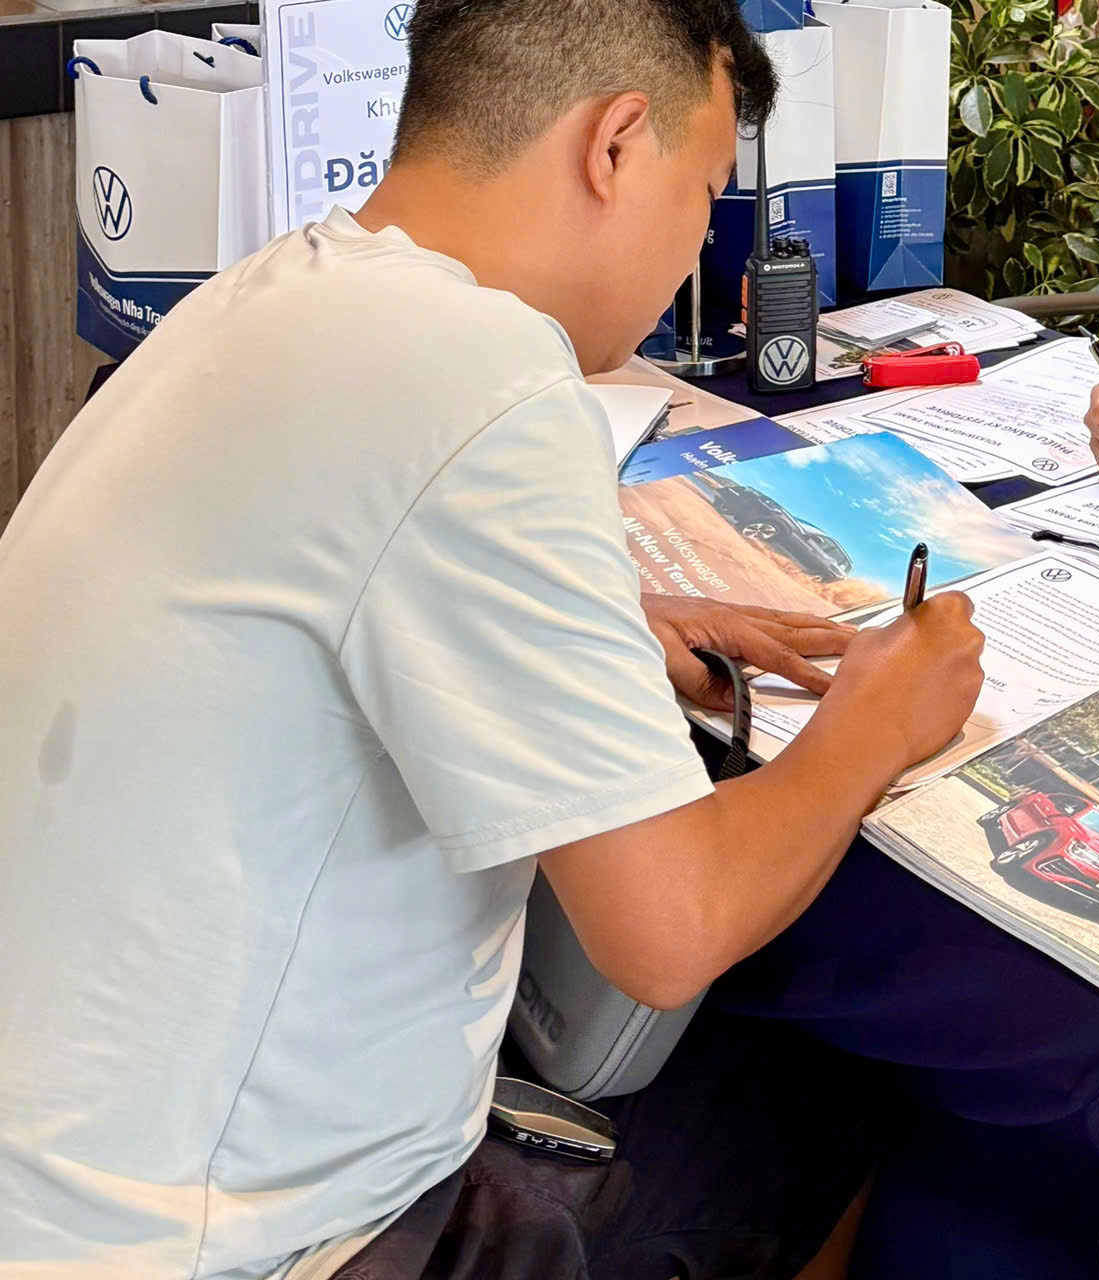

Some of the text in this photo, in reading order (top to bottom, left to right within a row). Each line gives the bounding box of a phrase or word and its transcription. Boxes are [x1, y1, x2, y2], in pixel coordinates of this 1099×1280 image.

[323, 63, 407, 86] Volkswagen
[122, 298, 144, 320] Nha
[662, 527, 732, 593] Volkswagen
